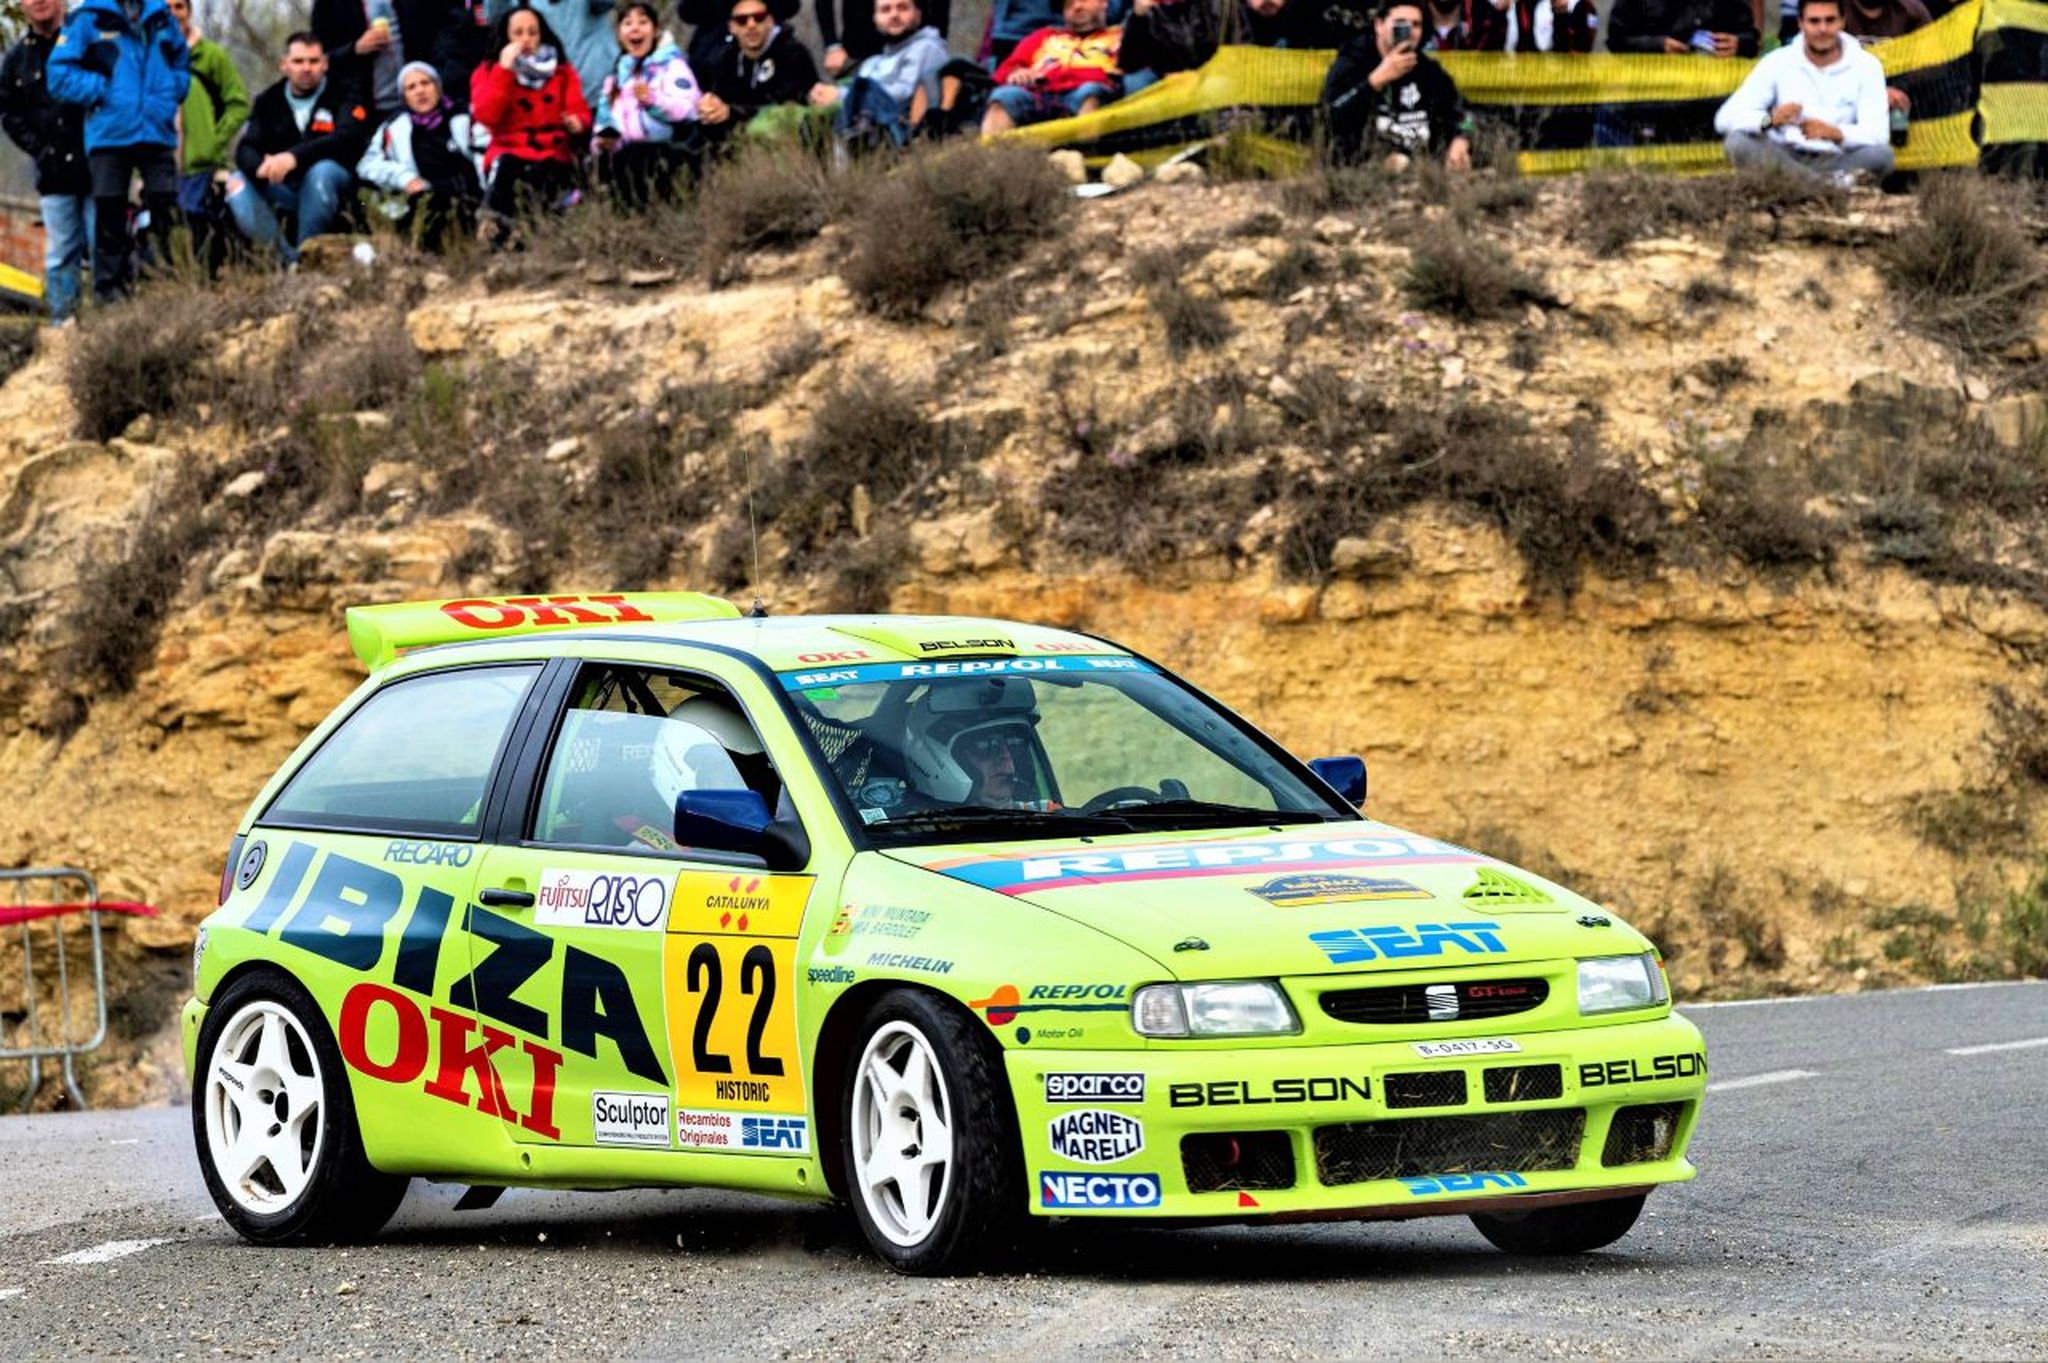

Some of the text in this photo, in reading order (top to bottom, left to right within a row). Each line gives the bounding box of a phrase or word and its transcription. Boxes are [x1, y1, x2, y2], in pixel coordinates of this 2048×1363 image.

[440, 596, 653, 629] OKI
[797, 650, 876, 663] OKI
[920, 639, 1015, 651] BELSON
[794, 669, 859, 685] SEAT
[900, 659, 1065, 677] REPSOL
[384, 840, 473, 867] RECARO
[1022, 838, 1450, 881] REPSOL
[539, 875, 666, 926] FUJITSU RISO
[706, 895, 770, 911] CATALUNYA
[1309, 922, 1508, 965] SEAT
[241, 841, 669, 1086] IBIZA
[807, 966, 856, 985] speedline
[867, 953, 954, 974] MICHELIN
[1028, 985, 1128, 999] REPSOL
[687, 942, 785, 1076] 22
[1037, 1029, 1064, 1039] Motor
[338, 982, 564, 1141] OKI
[1579, 1052, 1708, 1088] BELSON
[716, 1080, 770, 1102] HISTORIC
[1049, 1074, 1142, 1099] sparco
[1169, 1077, 1371, 1108] BELSON
[596, 1097, 666, 1131] Sculptor
[679, 1112, 731, 1127] Recambios
[1051, 1111, 1142, 1143] MAGNETI
[679, 1129, 729, 1146] Originales
[742, 1117, 806, 1149] SEAT
[1045, 1176, 1158, 1205] NECTO
[1396, 1171, 1530, 1196] SEAT
